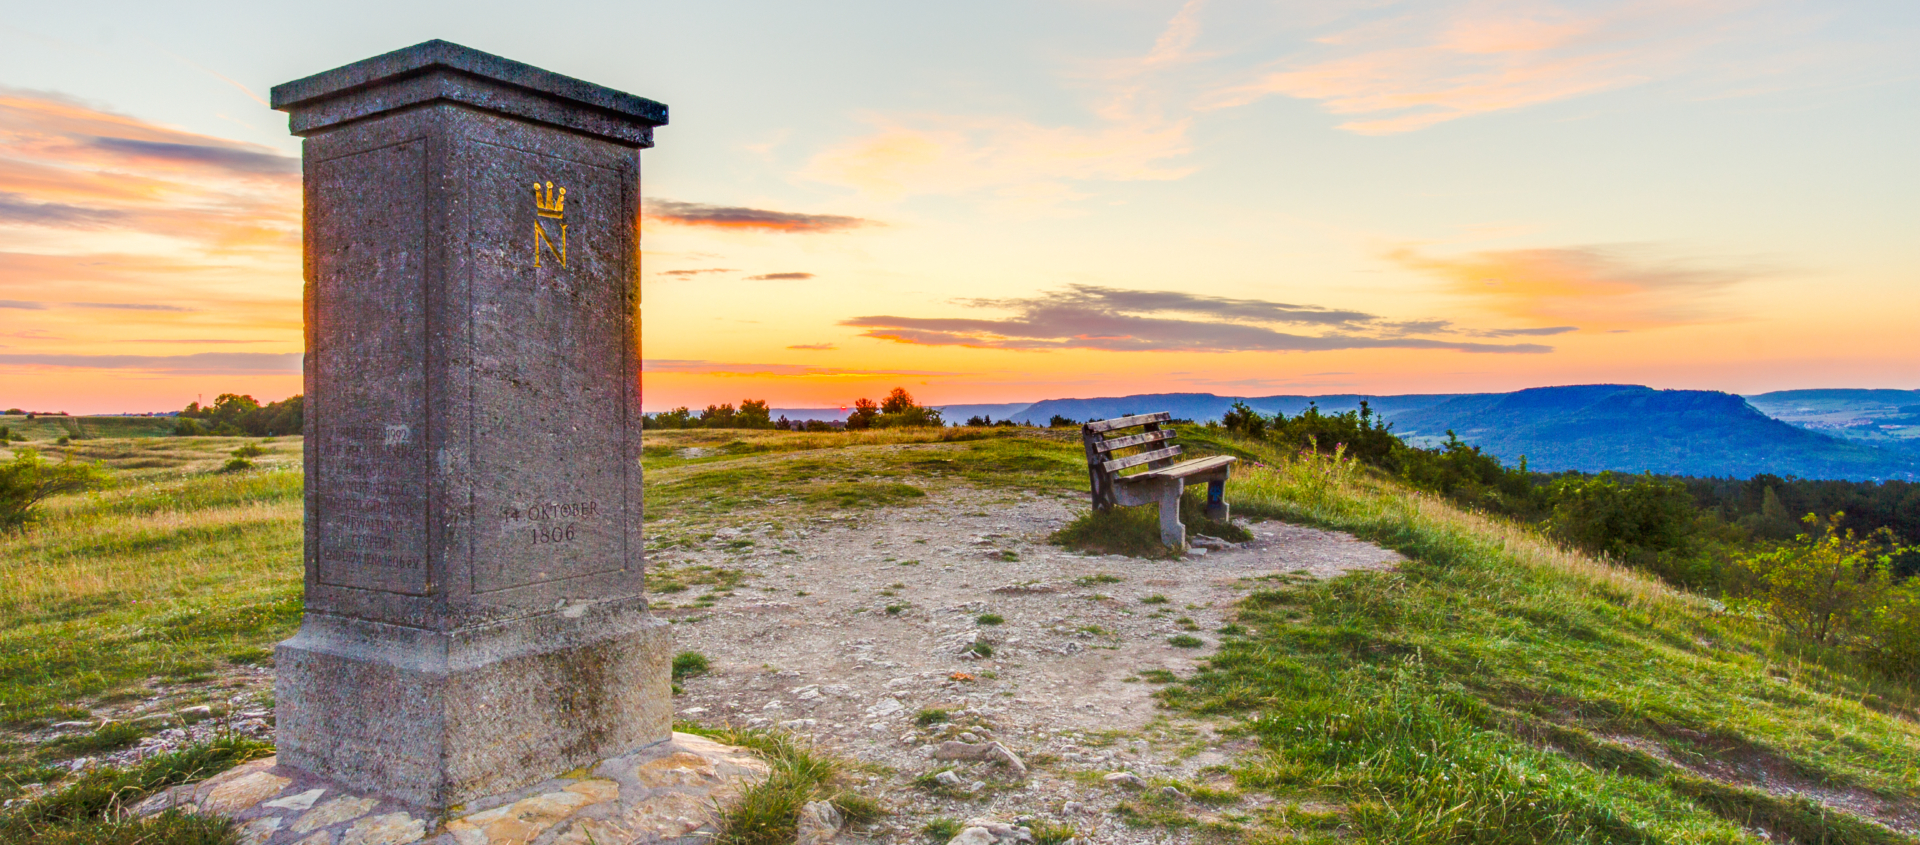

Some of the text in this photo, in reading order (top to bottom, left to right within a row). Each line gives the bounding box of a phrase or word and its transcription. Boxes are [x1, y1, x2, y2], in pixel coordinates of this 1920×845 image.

[533, 219, 568, 269] N
[386, 428, 407, 440] 1992
[528, 501, 600, 521] OKTOBER
[532, 522, 575, 545] 1806
[383, 555, 405, 569] 1806
